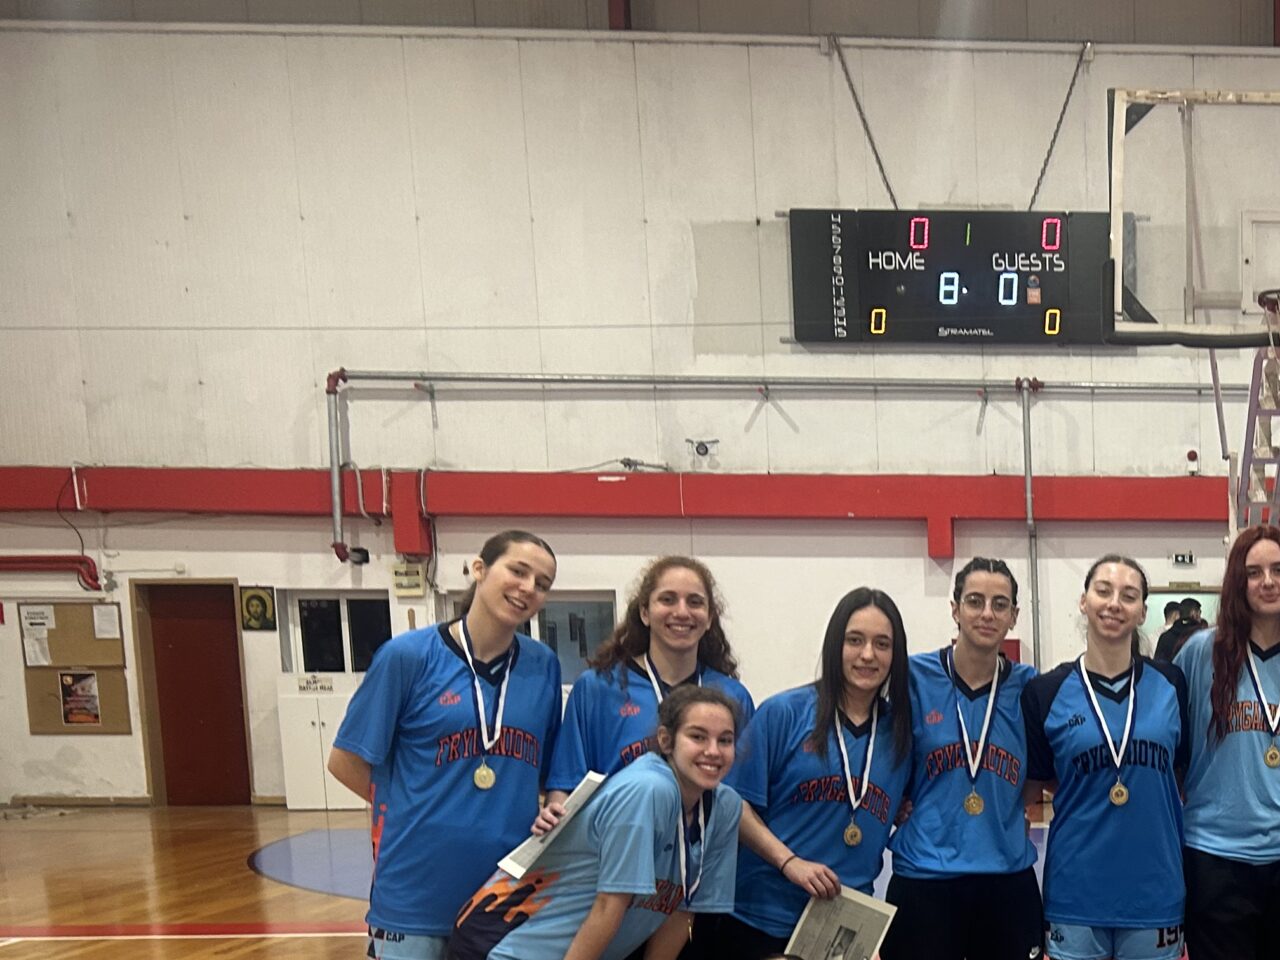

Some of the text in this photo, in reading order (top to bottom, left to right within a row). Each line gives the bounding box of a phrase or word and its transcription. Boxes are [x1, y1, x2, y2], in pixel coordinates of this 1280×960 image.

[910, 218, 929, 248] 0
[1042, 218, 1061, 250] 0
[869, 251, 925, 270] HOME
[992, 252, 1065, 272] GUESTS
[999, 272, 1018, 305] 0
[870, 308, 886, 334] 0
[1045, 308, 1060, 334] 0
